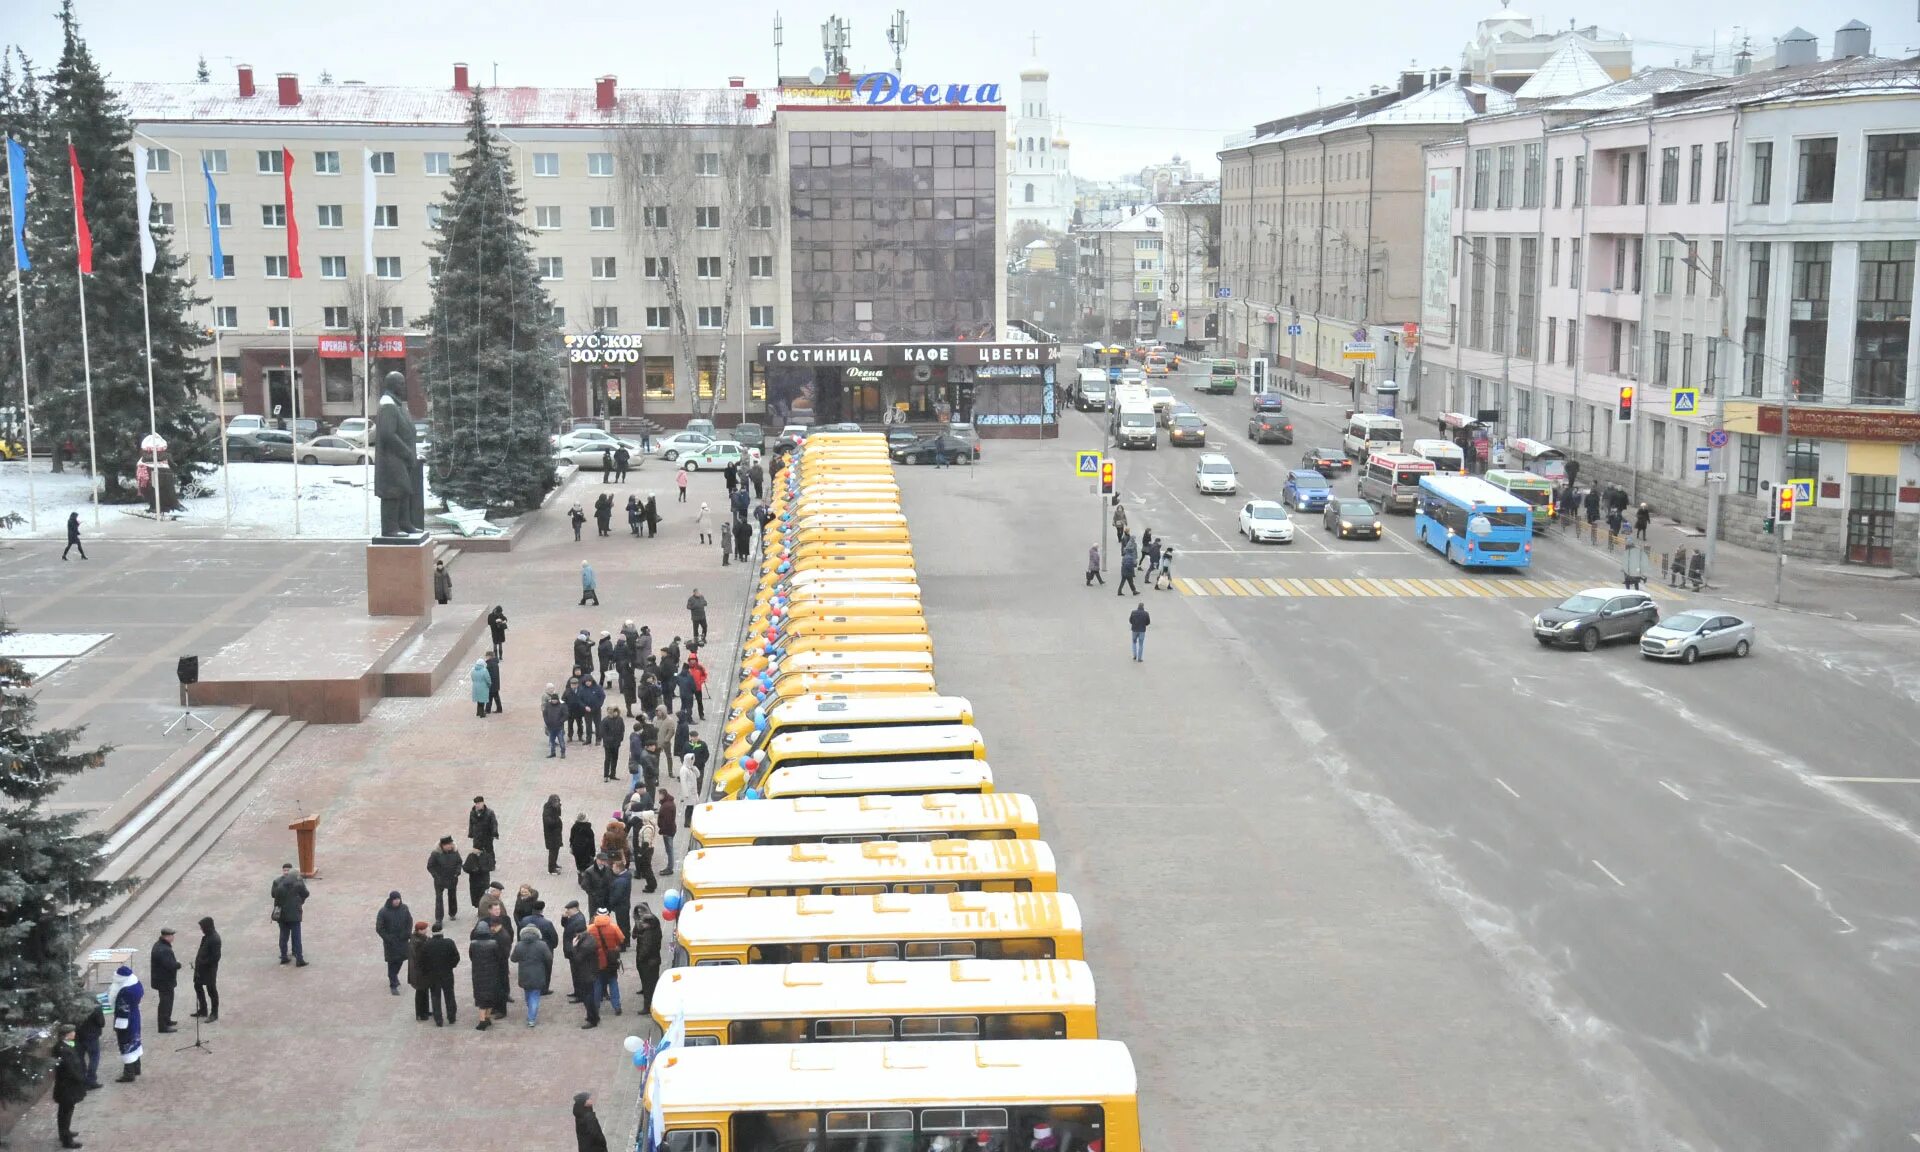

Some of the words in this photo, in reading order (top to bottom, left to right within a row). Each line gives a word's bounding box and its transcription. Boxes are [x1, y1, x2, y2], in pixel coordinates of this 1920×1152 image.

[856, 72, 1001, 105] Десна
[766, 349, 874, 363] ГОСТИНИЦА
[904, 348, 949, 361] КАФЕ
[979, 348, 1039, 362] ЦВЕТЫ
